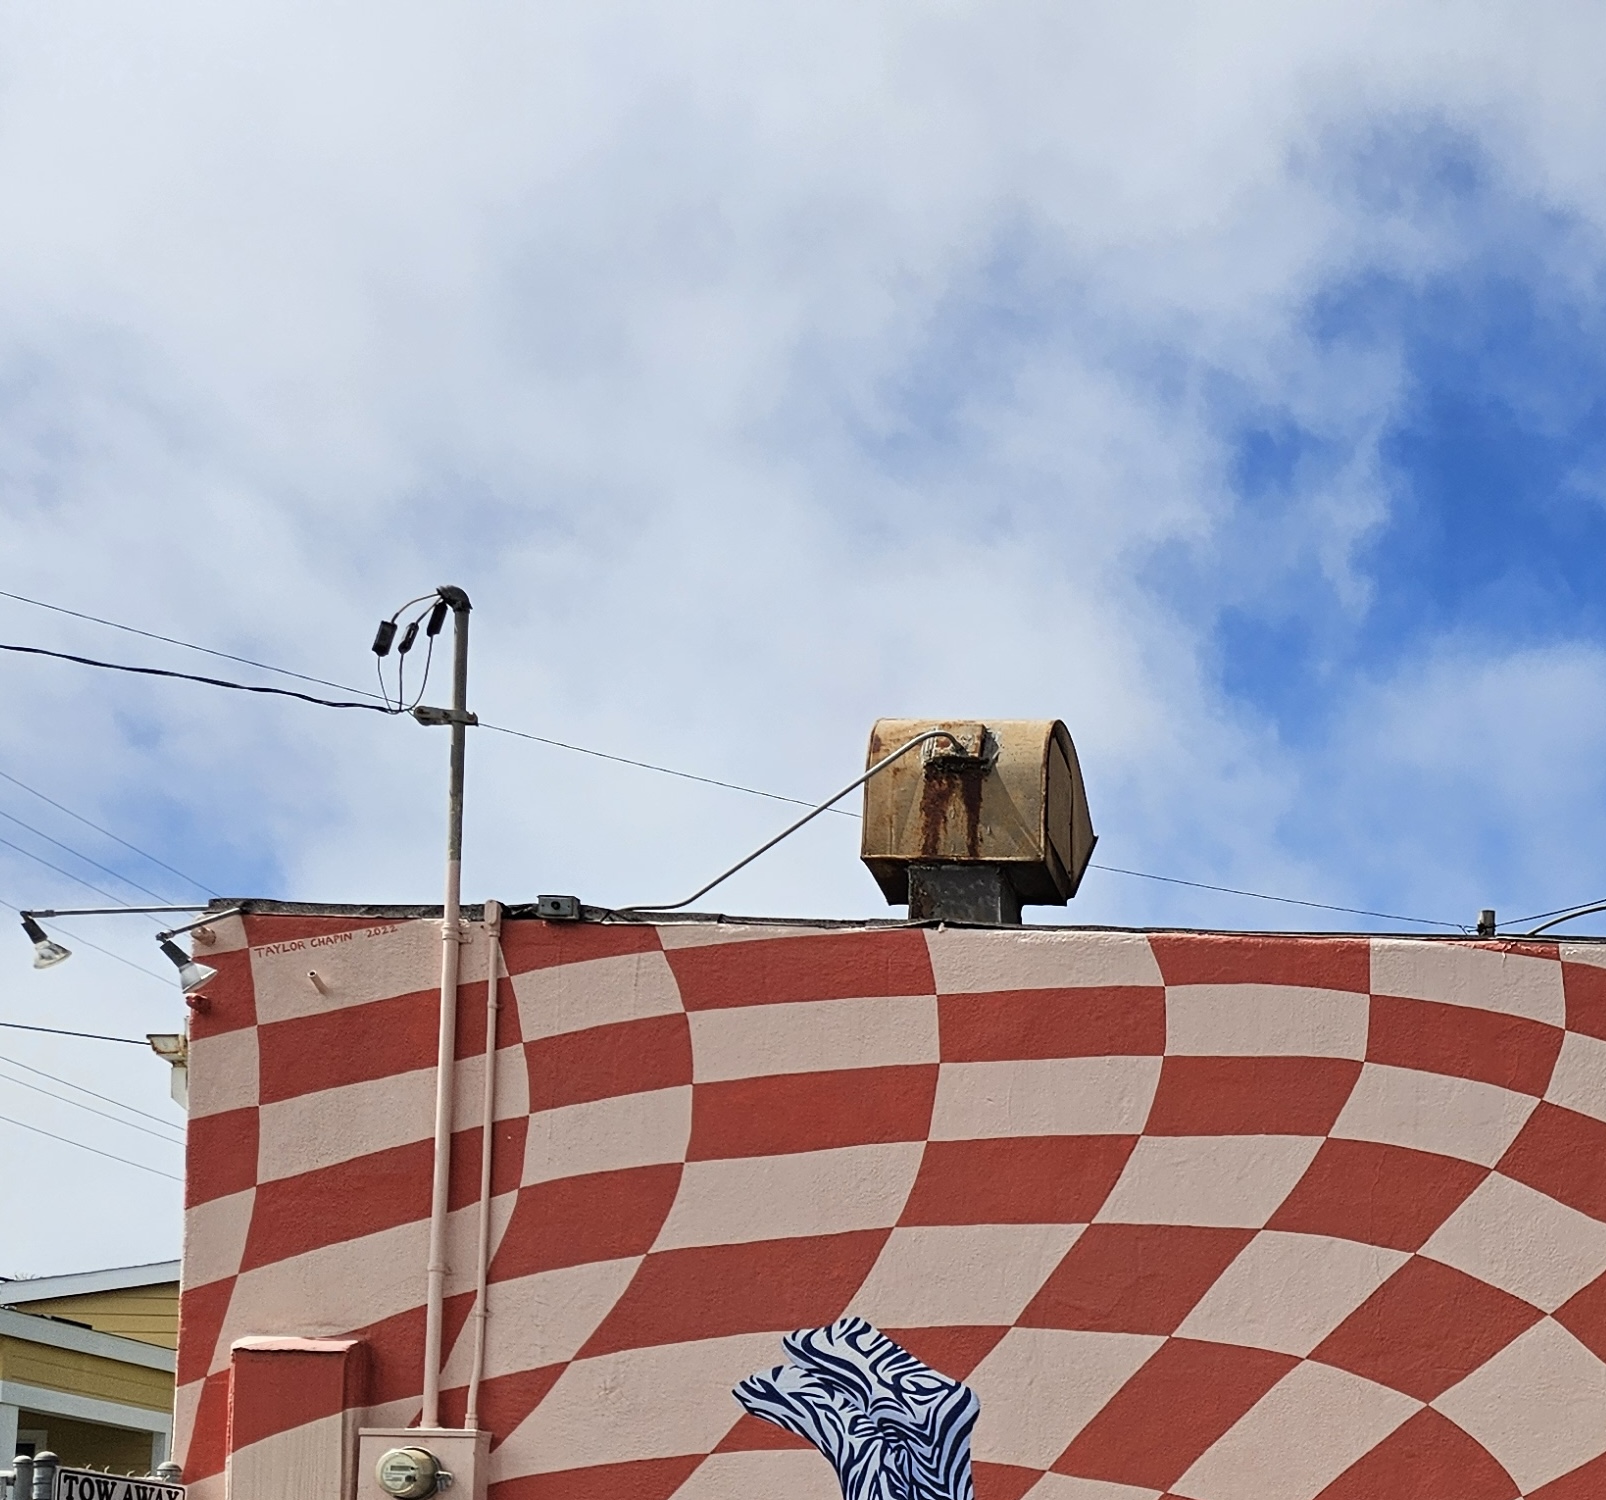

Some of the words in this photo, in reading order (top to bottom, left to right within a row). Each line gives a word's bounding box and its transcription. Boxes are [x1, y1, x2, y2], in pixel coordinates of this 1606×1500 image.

[254, 941, 305, 958] TAYLOR
[310, 932, 353, 947] CHAPIN
[367, 924, 398, 938] 2022
